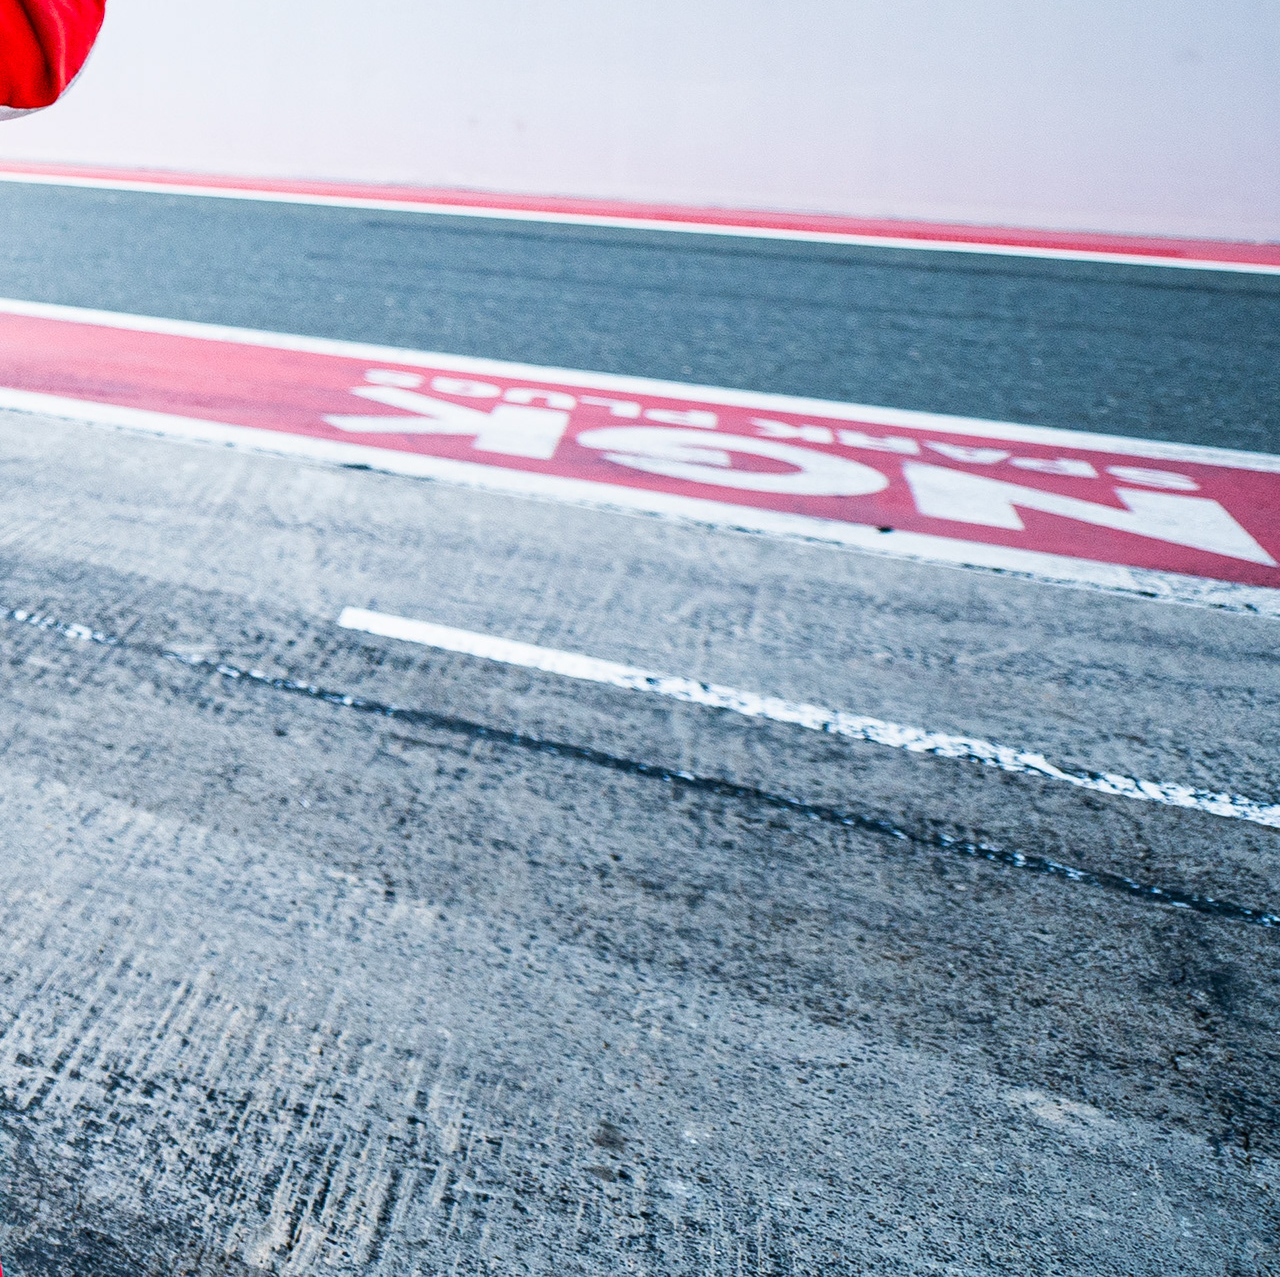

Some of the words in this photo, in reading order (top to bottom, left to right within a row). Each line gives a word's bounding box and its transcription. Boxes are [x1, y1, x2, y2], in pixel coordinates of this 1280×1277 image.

[362, 366, 720, 429] PLUGS
[324, 385, 1278, 568] NGK
[756, 415, 1202, 492] SPARK
